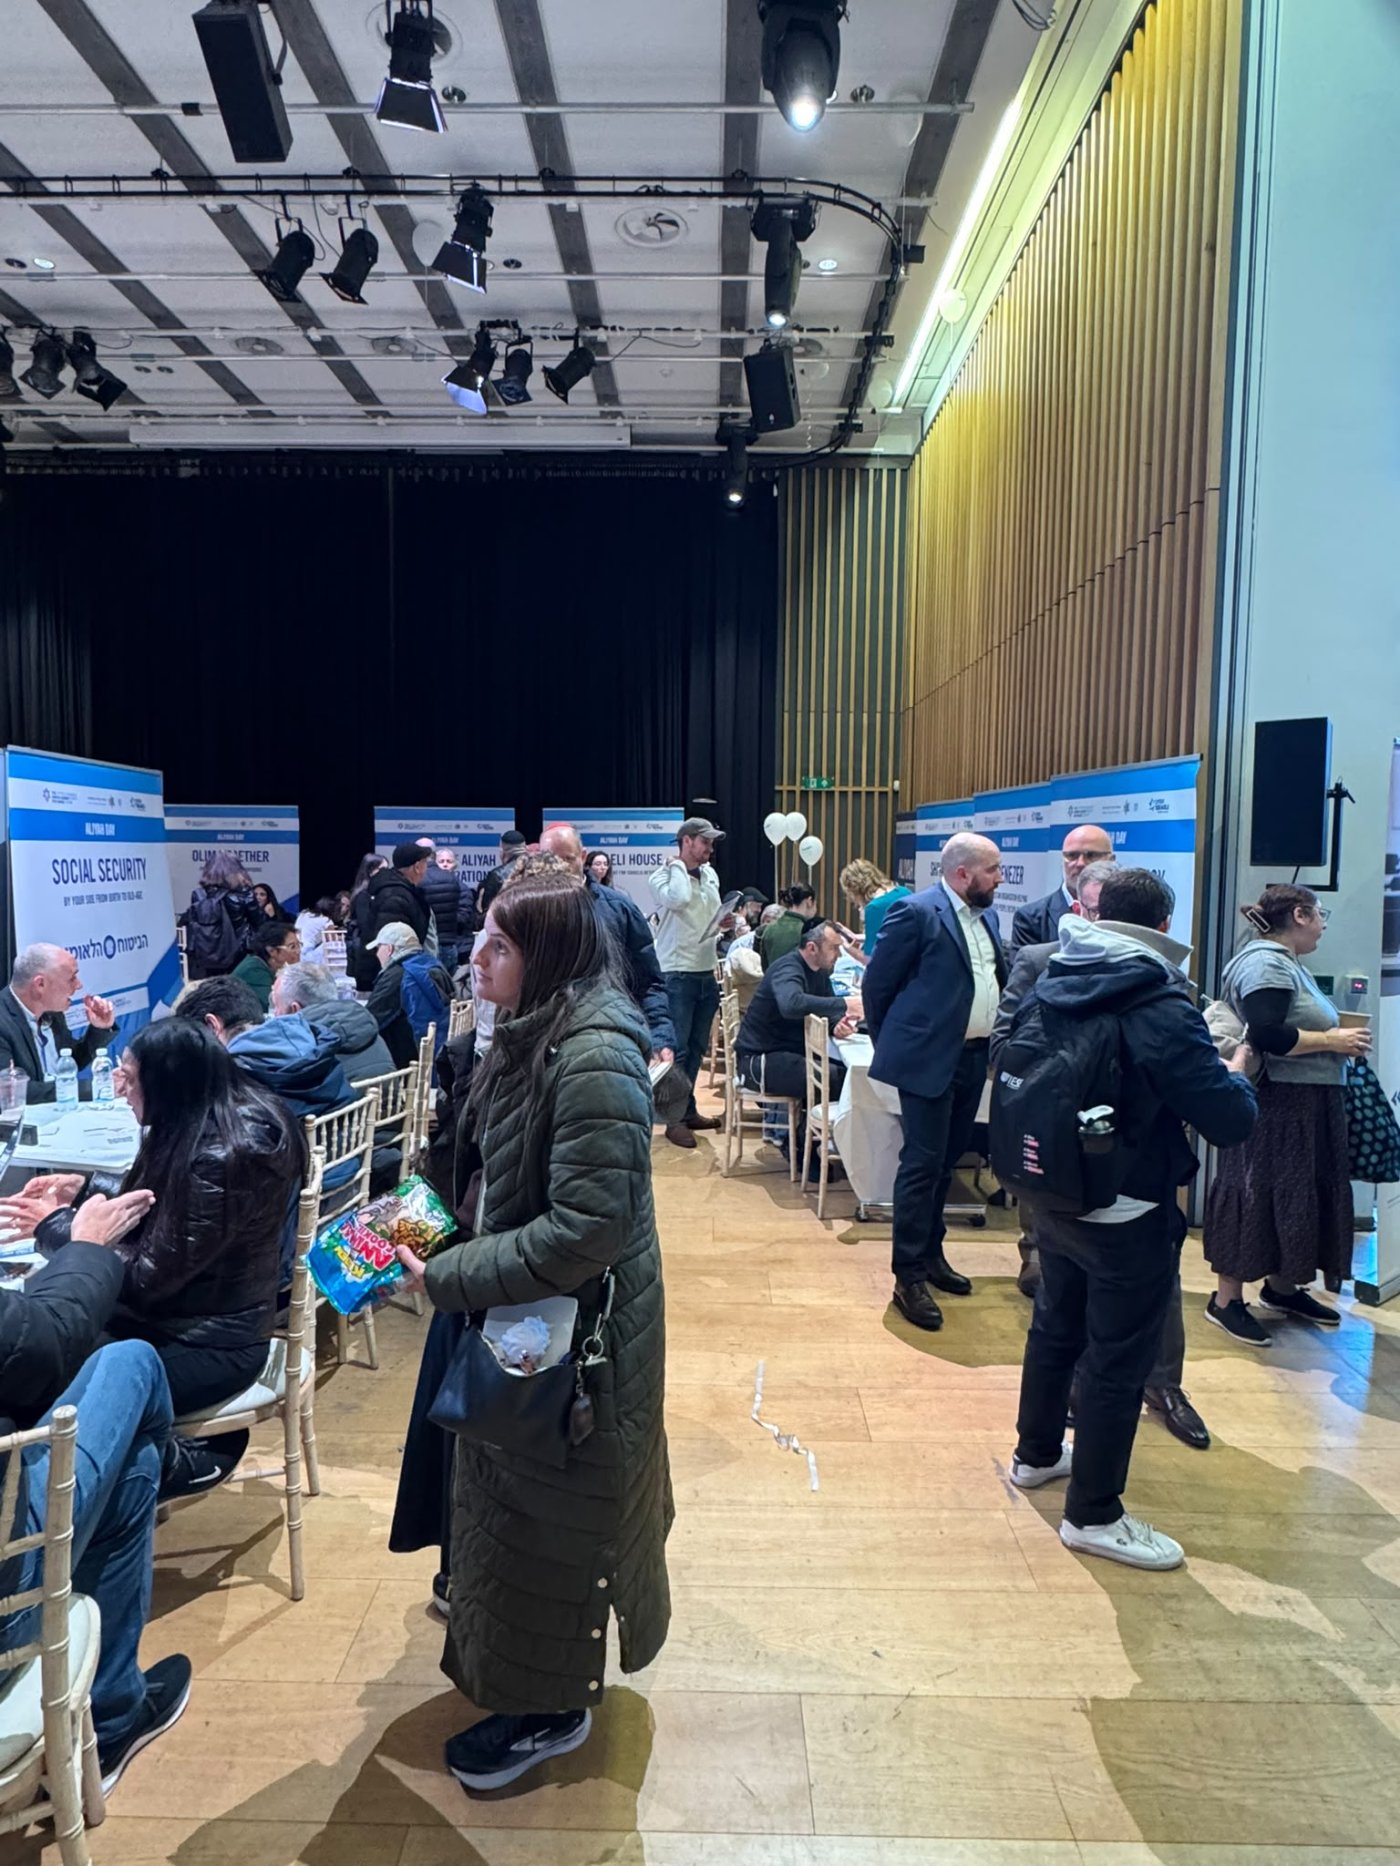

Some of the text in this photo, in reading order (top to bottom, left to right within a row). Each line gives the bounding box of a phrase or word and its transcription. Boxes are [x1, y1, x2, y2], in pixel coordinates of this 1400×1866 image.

[462, 854, 496, 867] ALIYAH
[629, 853, 664, 866] HOUSE
[52, 857, 146, 885] SOCIAL SECURITY
[117, 934, 149, 953] הביטוח
